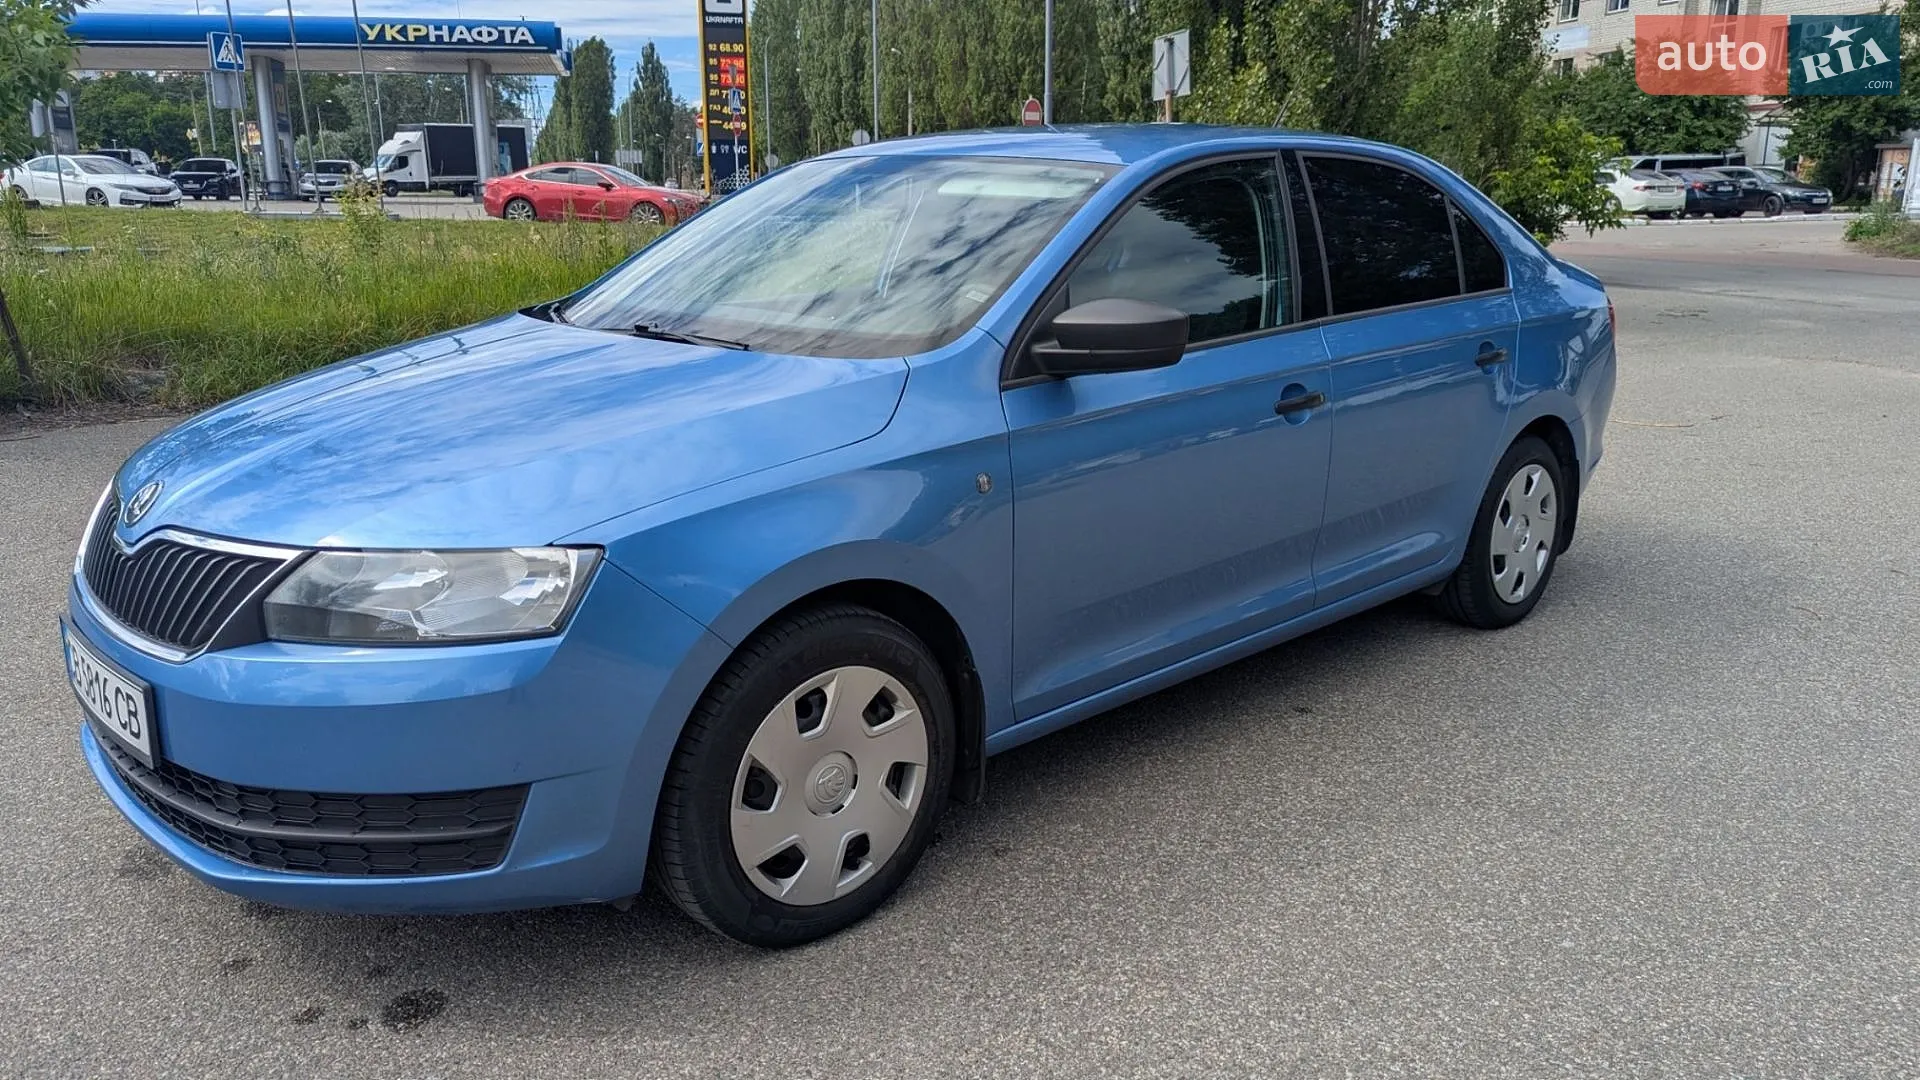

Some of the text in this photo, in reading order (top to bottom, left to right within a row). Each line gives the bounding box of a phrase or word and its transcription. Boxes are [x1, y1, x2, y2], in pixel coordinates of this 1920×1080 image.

[705, 15, 744, 24] UKRNAFTA
[360, 23, 535, 44] УКРНАФТА
[719, 42, 744, 53] 68.90
